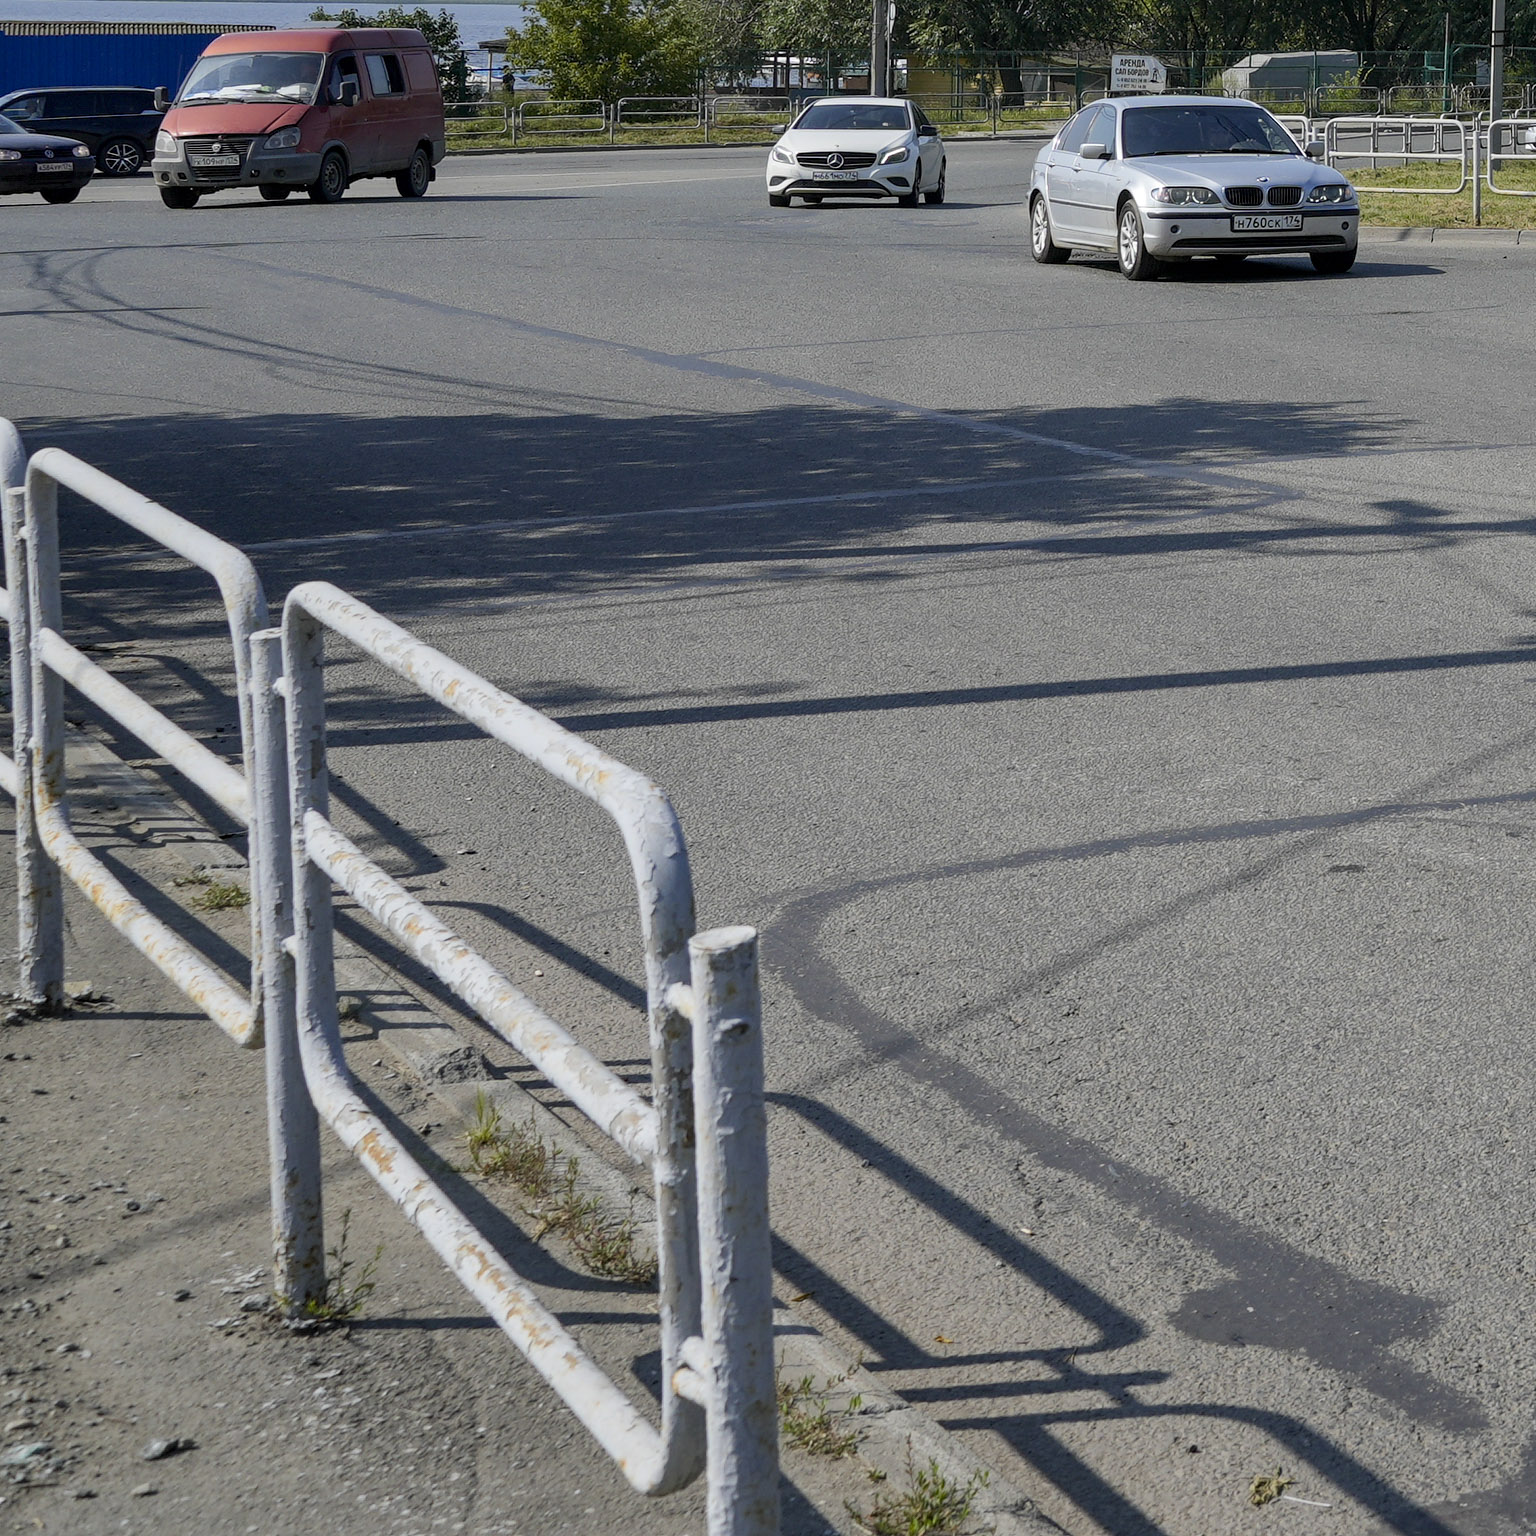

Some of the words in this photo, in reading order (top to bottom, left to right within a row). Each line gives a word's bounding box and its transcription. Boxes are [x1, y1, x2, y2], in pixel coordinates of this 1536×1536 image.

[1120, 58, 1146, 67] АРЕНДА
[1115, 67, 1127, 75] САП
[1237, 217, 1281, 229] Н760СК
